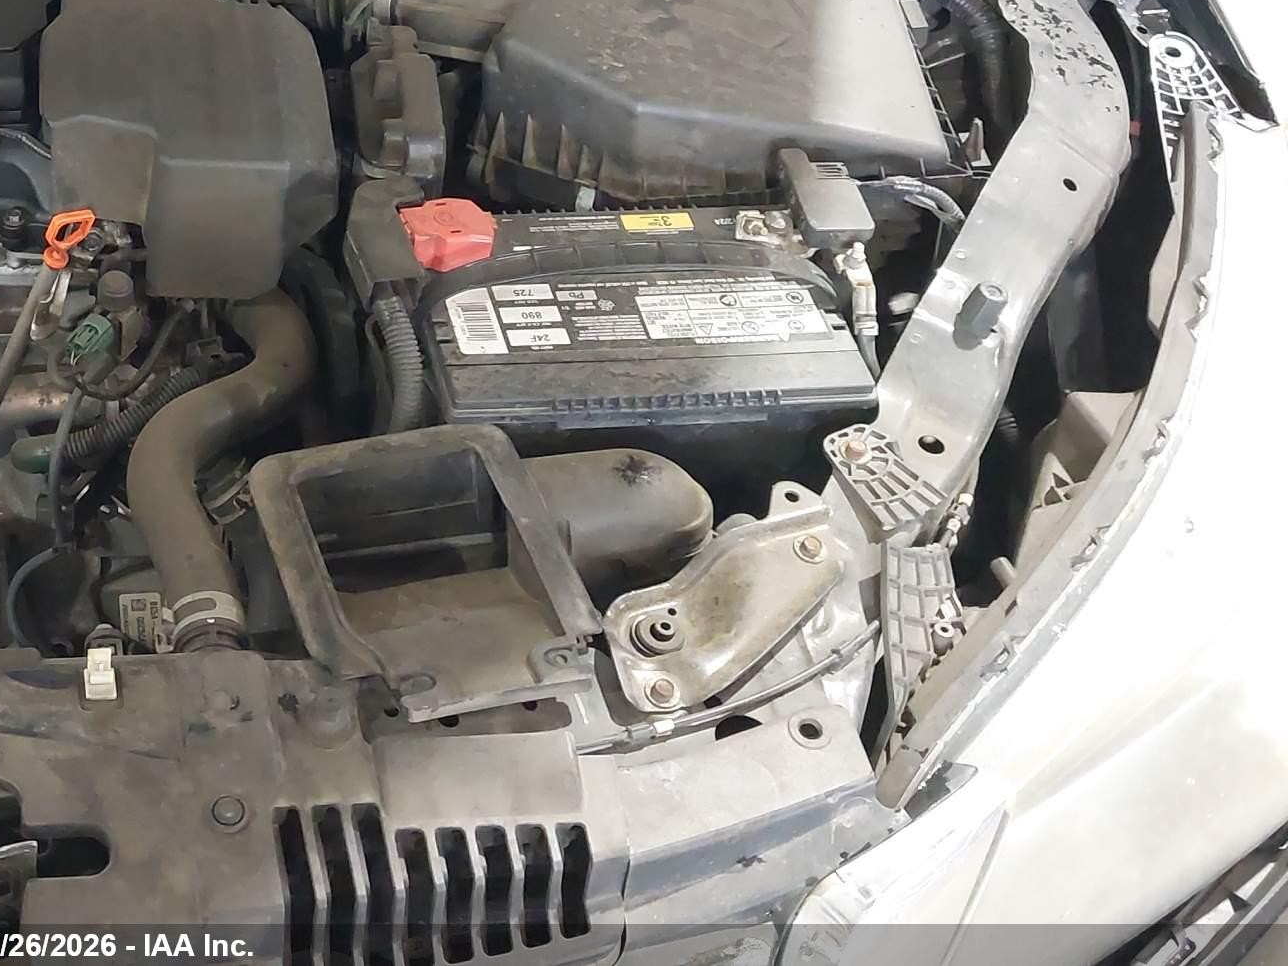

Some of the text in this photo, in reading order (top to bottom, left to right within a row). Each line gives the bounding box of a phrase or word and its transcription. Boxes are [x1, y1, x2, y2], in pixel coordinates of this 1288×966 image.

[512, 289, 535, 297] 725
[568, 291, 585, 300] Pb
[521, 311, 542, 320] 890
[530, 333, 551, 343] 24F
